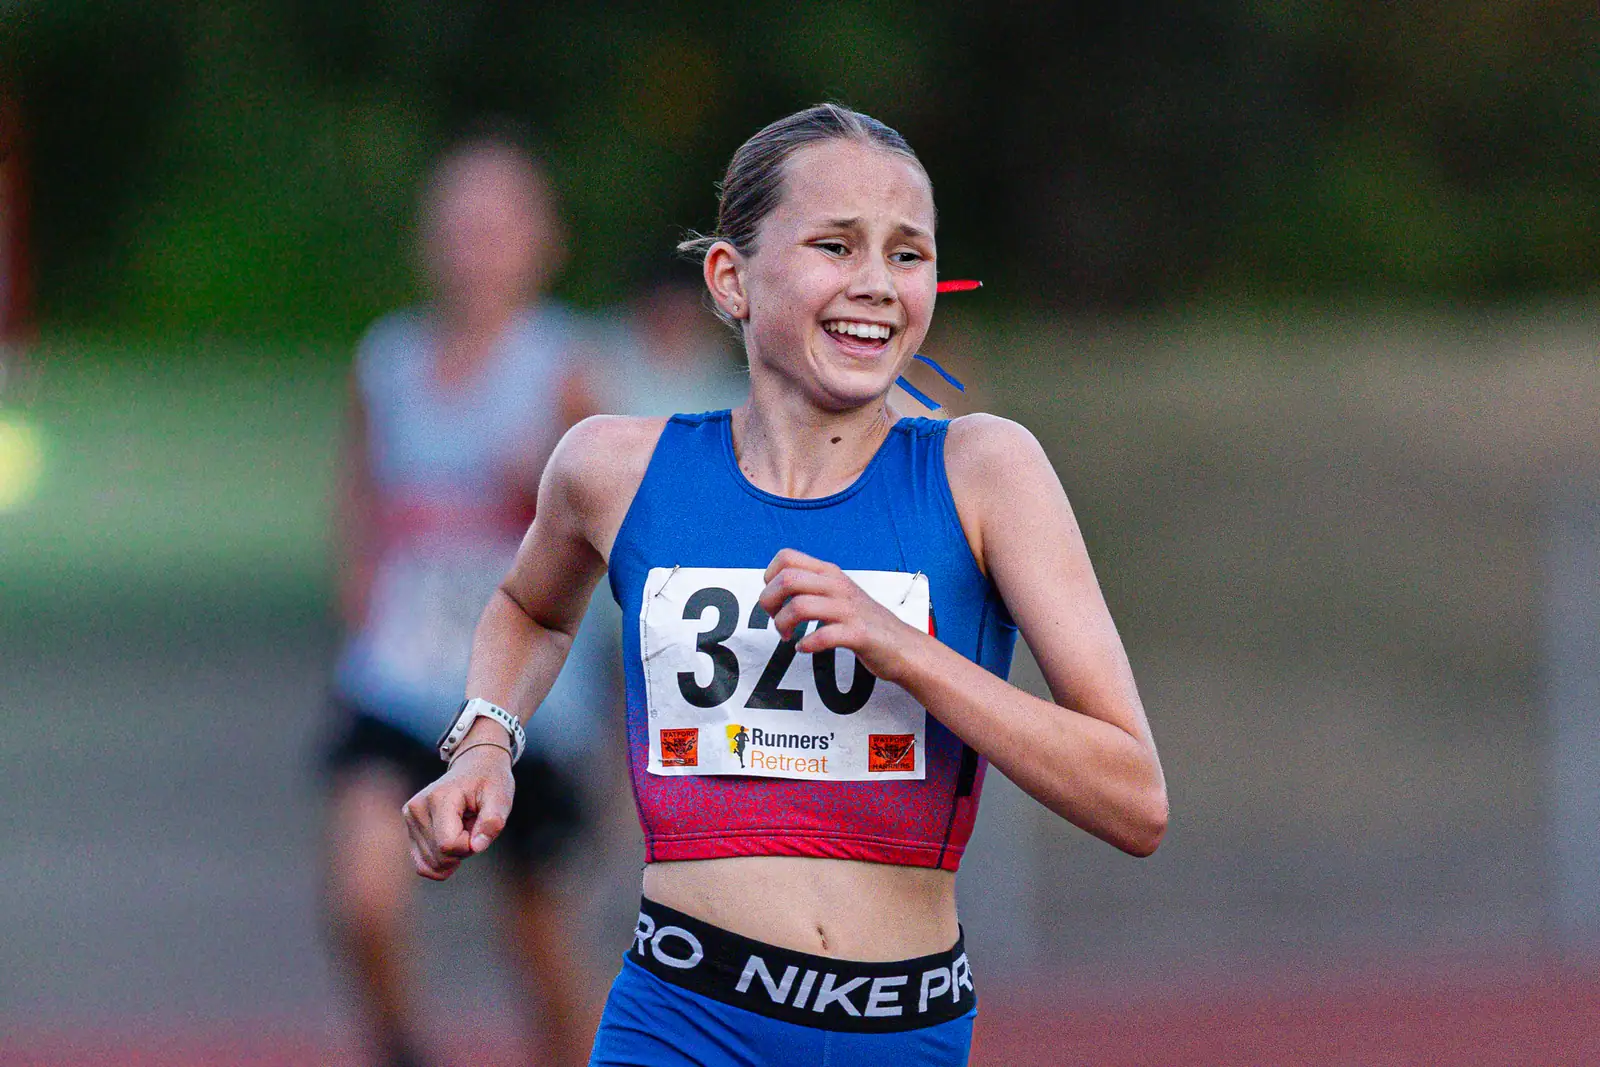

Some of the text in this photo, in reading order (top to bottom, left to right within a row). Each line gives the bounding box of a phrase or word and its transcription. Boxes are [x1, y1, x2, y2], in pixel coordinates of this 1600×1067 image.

[676, 586, 877, 716] 320
[663, 730, 696, 738] WATFORD
[751, 727, 835, 750] Runners'
[750, 750, 829, 774] Retreat
[632, 911, 974, 1018] RO NIKE PR
